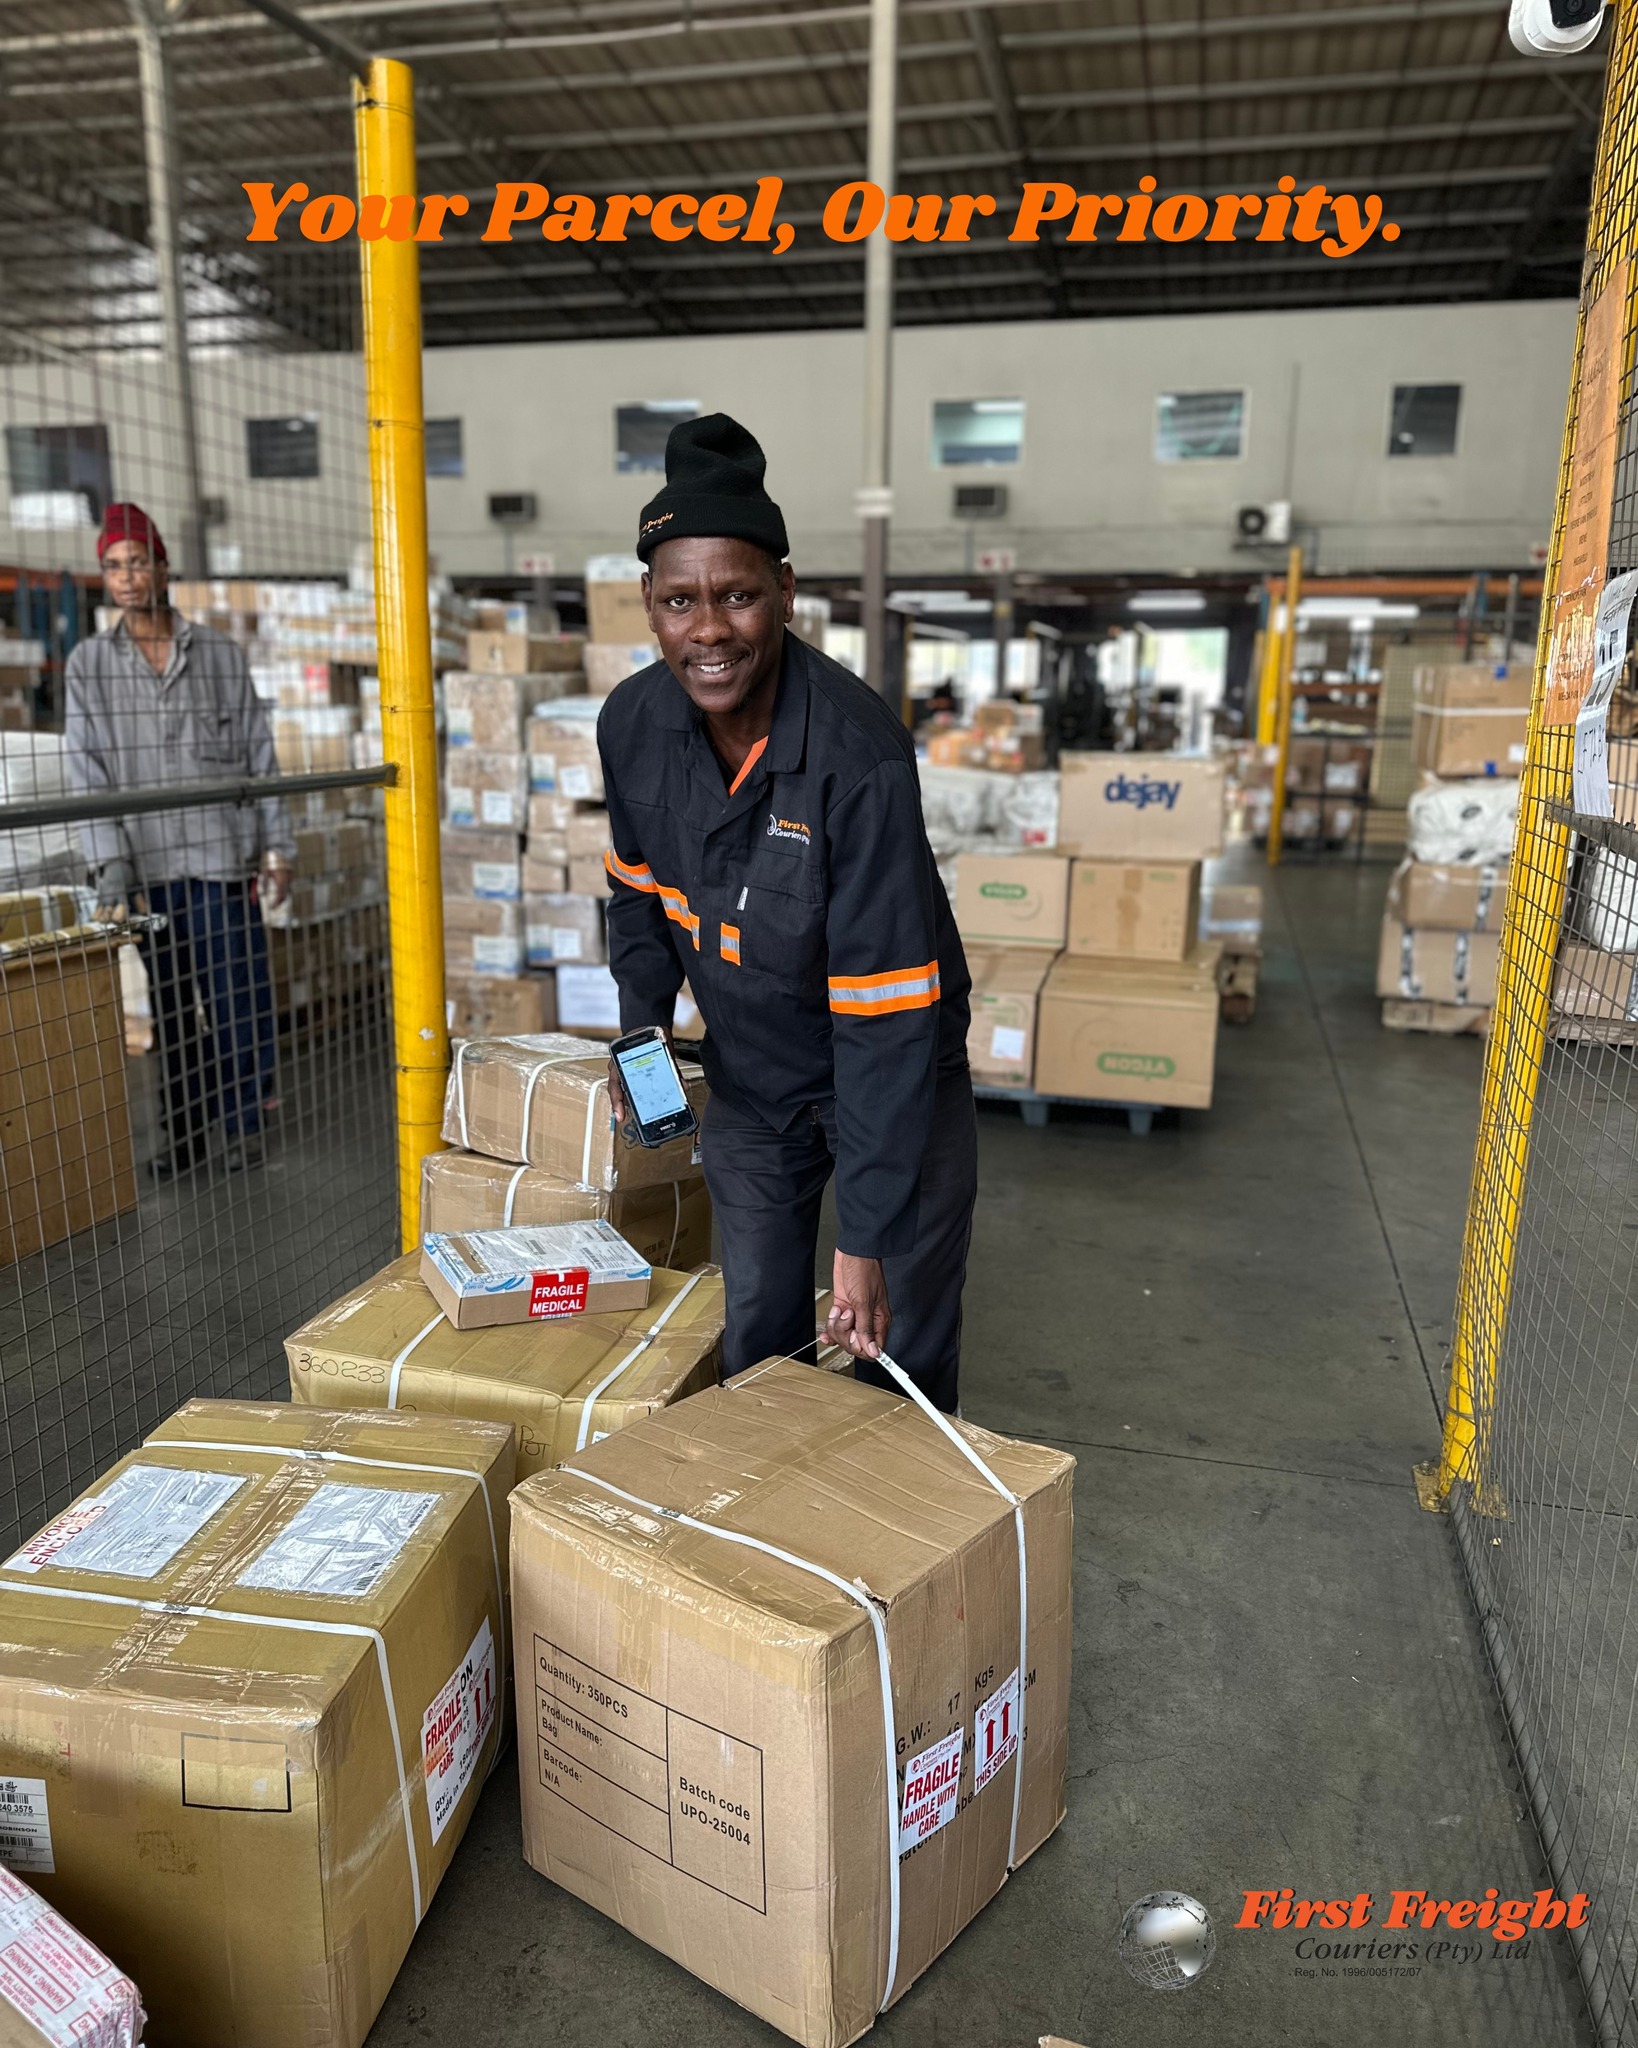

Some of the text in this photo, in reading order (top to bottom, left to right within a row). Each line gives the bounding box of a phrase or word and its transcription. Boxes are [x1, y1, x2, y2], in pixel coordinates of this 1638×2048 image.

[1105, 773, 1181, 811] dejay
[777, 819, 801, 830] First
[532, 1299, 582, 1313] MEDICAL
[535, 1283, 584, 1298] FRAGILE
[22, 1510, 84, 1555] INVOICE
[30, 1505, 107, 1565] ENCLOSED
[540, 1656, 629, 1719] Quantity: 350PCS
[975, 1665, 994, 1692] Kgs
[948, 1692, 960, 1715] 17
[426, 1689, 461, 1756] FRAGILE
[449, 1717, 462, 1746] WITH
[541, 1699, 603, 1747] Product Name:
[542, 1717, 558, 1738] Bag
[439, 1747, 454, 1778] CARE
[922, 1747, 938, 1763] First
[938, 1733, 961, 1753] Freight
[976, 1734, 1017, 1790] THIS SIDE UP
[544, 1749, 582, 1783] Barcode:
[544, 1769, 560, 1787] N/A
[905, 1753, 959, 1809] FRAGILE
[14, 1804, 33, 1814] 3575
[436, 1796, 452, 1826] Made
[453, 1784, 459, 1797] in
[680, 1776, 750, 1820] Batch code
[902, 1797, 935, 1831] HANDLE
[937, 1782, 957, 1807] WITH
[680, 1801, 750, 1846] UPO-25004
[918, 1810, 940, 1838] CARE
[5, 1948, 35, 1976] WARNING
[1, 1971, 37, 2006] SECURITY TAPE
[34, 1976, 66, 2007] WARNING
[19, 2001, 37, 2019] CARTON
